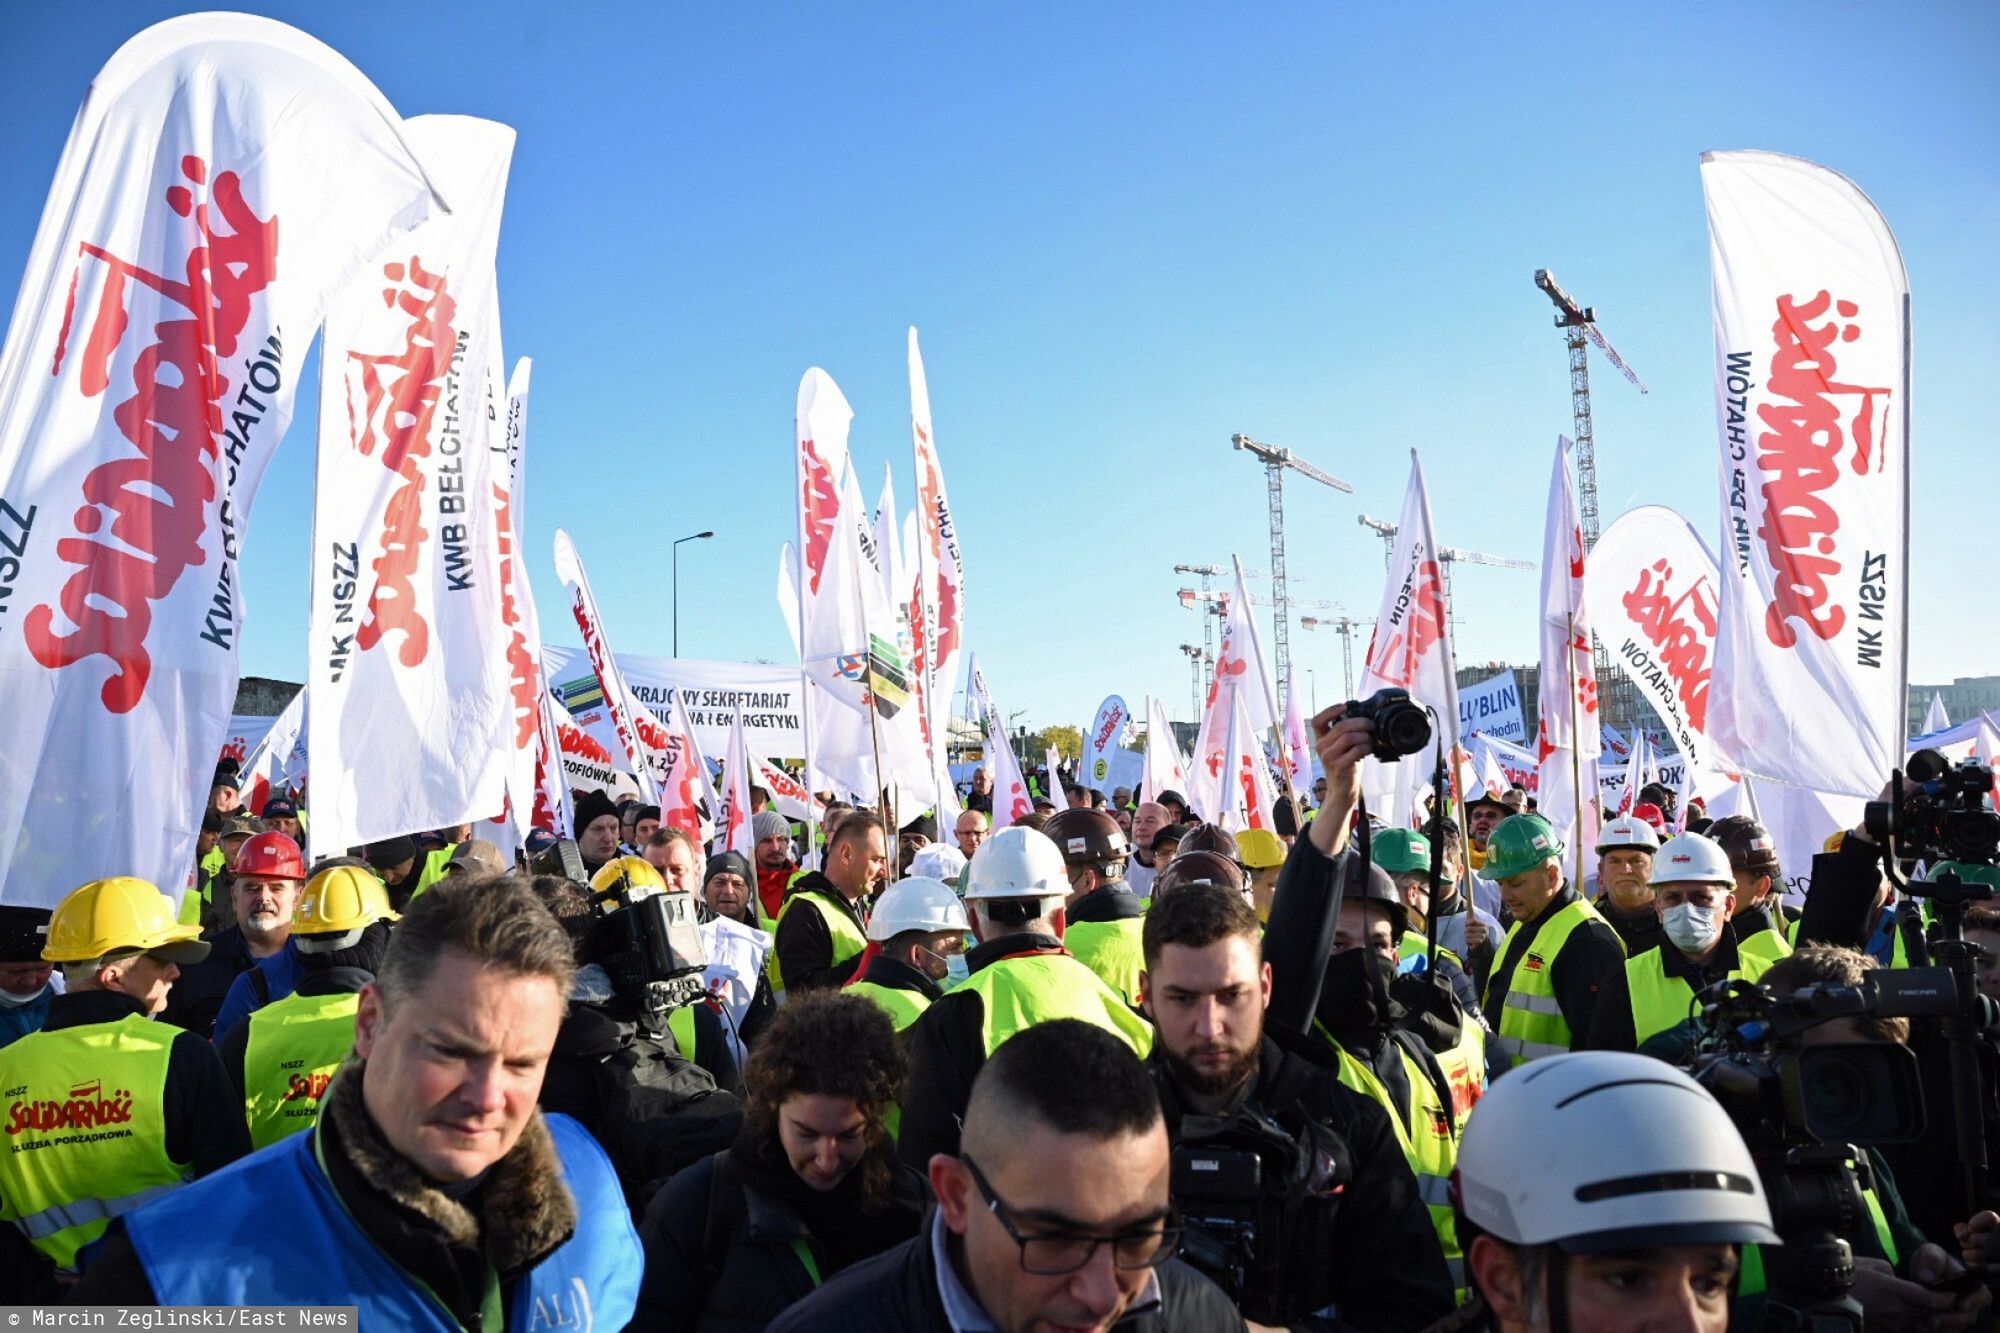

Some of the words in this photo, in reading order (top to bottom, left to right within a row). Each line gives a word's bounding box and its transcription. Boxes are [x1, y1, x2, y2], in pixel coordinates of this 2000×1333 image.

[440, 523, 477, 592] KWB
[332, 542, 359, 623] NSZZ
[702, 690, 791, 708] SEKRETARIAT
[1459, 684, 1516, 722] LUBLIN
[716, 712, 800, 729] ENRGETYKI
[281, 1060, 305, 1070] NSZZ
[4, 1085, 28, 1098] NSZZ
[54, 1128, 133, 1146] PORZĄDKOWA
